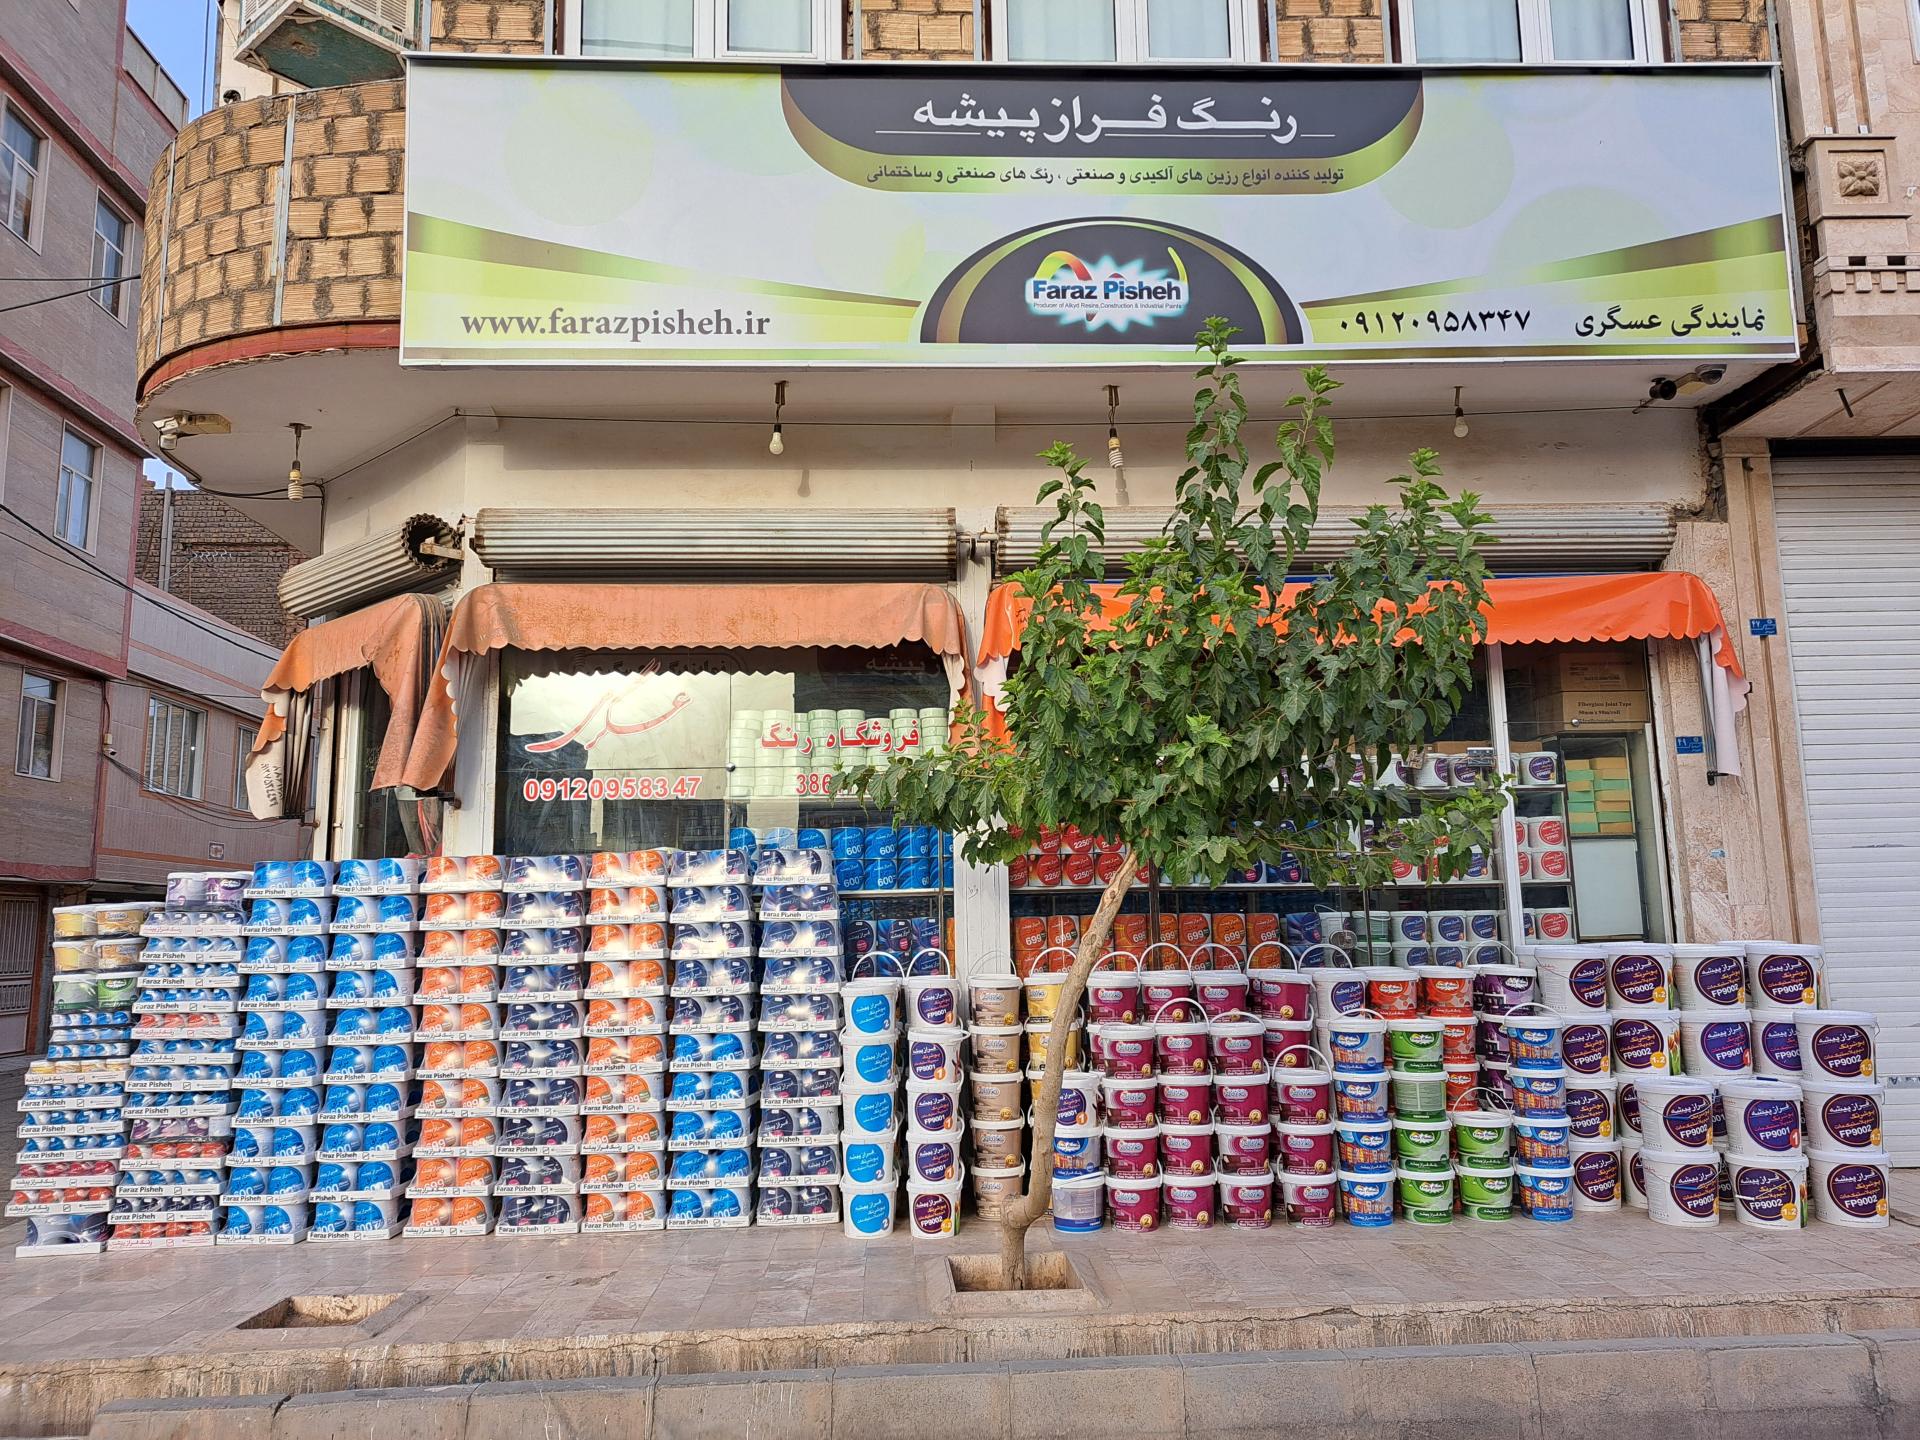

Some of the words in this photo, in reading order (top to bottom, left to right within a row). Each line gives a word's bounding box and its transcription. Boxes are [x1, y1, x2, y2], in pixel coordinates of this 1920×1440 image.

[913, 92, 1041, 144] پیشه
[1043, 93, 1167, 144] فراز
[1176, 96, 1298, 144] رنگ
[867, 165, 932, 184] ساختمانی
[934, 171, 943, 184] و
[947, 166, 996, 185] صنعتی
[999, 166, 1027, 183] های
[1029, 167, 1054, 185] رنگ
[1065, 166, 1115, 186] صنعتی
[1118, 172, 1126, 184] و
[1129, 166, 1174, 185] آلکیدی
[1176, 167, 1203, 184] های
[1206, 170, 1239, 187] رزین
[1242, 169, 1271, 187] انواع
[1274, 169, 1310, 182] کننده
[1313, 168, 1345, 185] تولید
[1033, 280, 1098, 300] Faraz
[1104, 280, 1181, 300] Pisheh
[461, 307, 770, 343] www.farazpisheh.ir
[1340, 309, 1531, 334] ۰۹۱۲۰۹۵۸۳۴۷
[1575, 305, 1662, 338] عسگری
[1671, 305, 1766, 338] نمایندگی
[761, 722, 813, 754] رنگ
[826, 719, 921, 753] فروشگاه
[522, 775, 703, 802] 09120958347
[846, 845, 862, 855] 600
[880, 845, 895, 855] 600
[844, 876, 860, 886] 600
[877, 876, 893, 887] 600
[1624, 983, 1655, 996] FP9002
[1711, 984, 1739, 998] FP9002
[1772, 984, 1804, 997] FP9002
[1573, 1053, 1602, 1066] FP9002
[1623, 1048, 1652, 1060] FP9002
[1715, 1048, 1744, 1061] FP9001
[1828, 1055, 1862, 1069] FP9002
[1571, 1117, 1601, 1130] FP9002
[1680, 1124, 1708, 1139] FP9002
[1759, 1127, 1791, 1140] FP9001
[1839, 1125, 1872, 1139] FP9002
[1588, 1180, 1615, 1194] FP9002
[1687, 1194, 1714, 1209] FP9002
[1749, 1199, 1784, 1210] FP9002
[1844, 1195, 1878, 1209] FP9002
